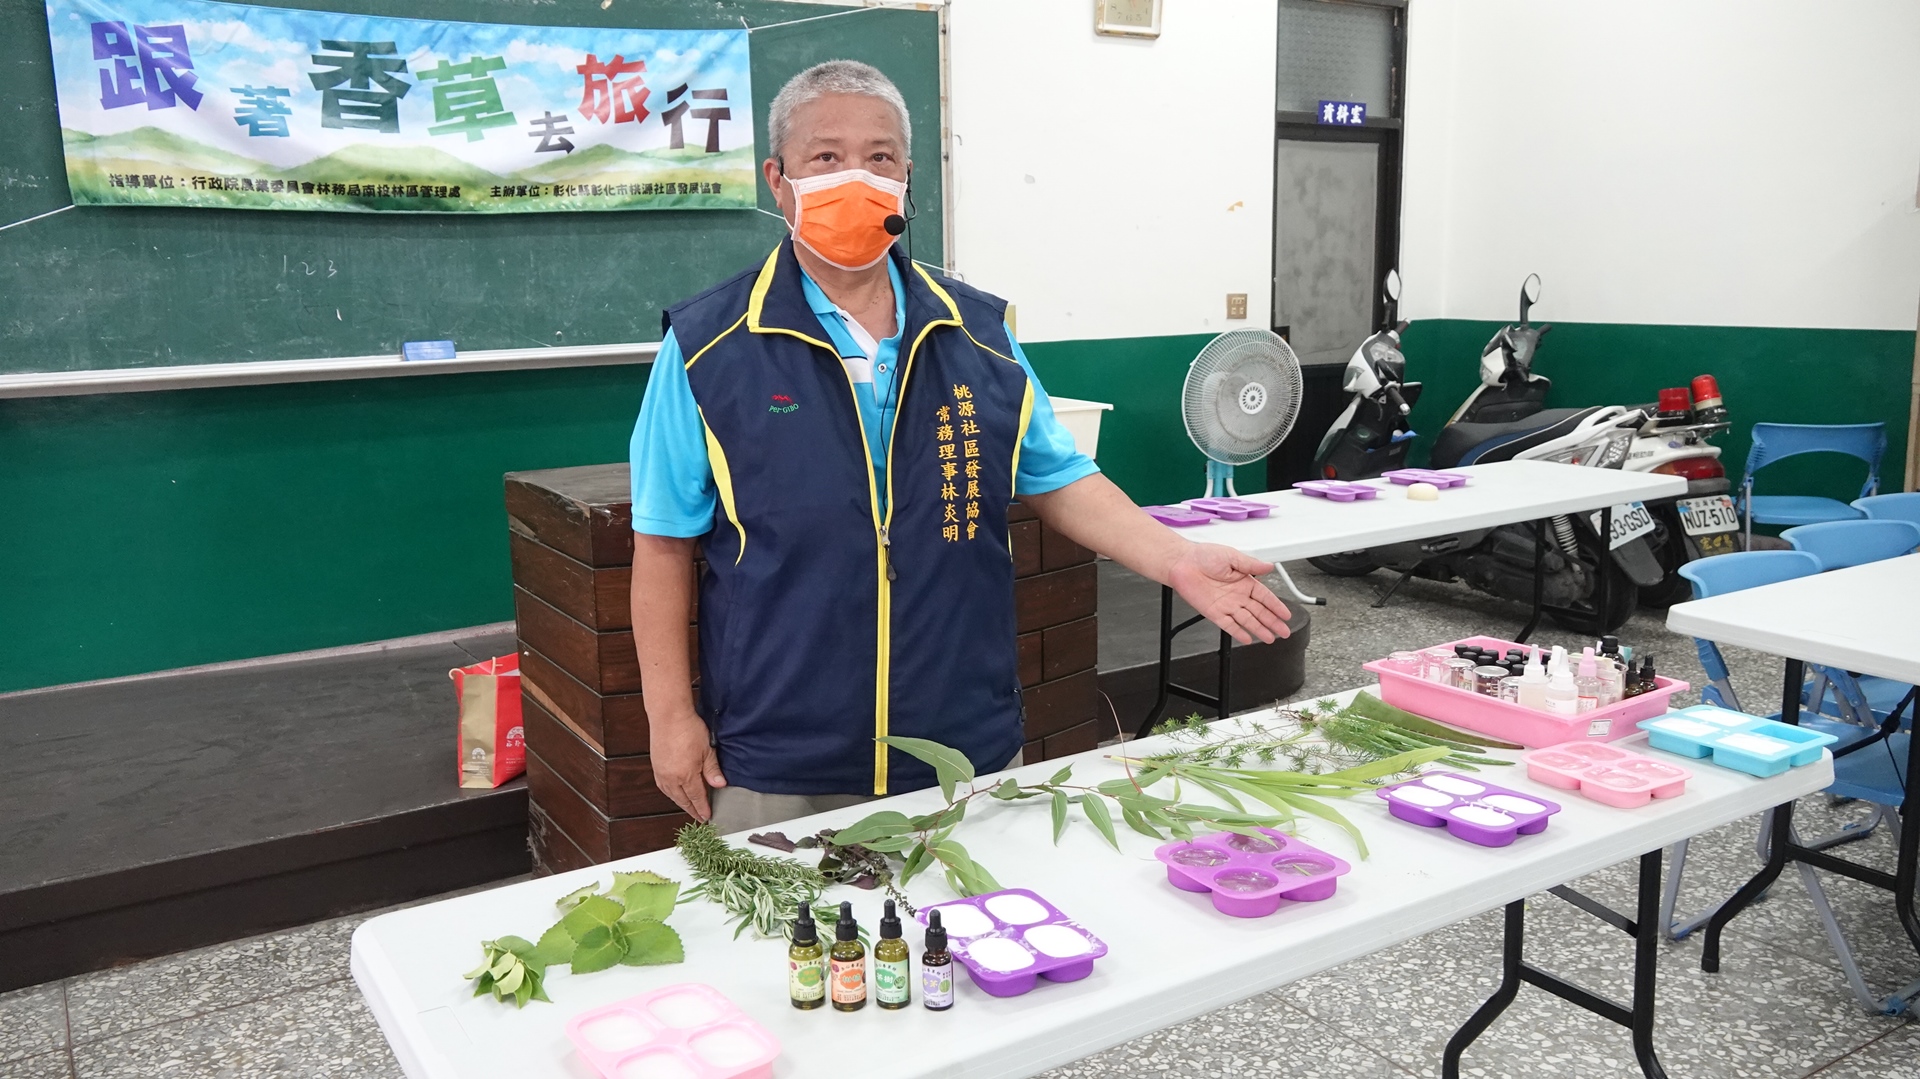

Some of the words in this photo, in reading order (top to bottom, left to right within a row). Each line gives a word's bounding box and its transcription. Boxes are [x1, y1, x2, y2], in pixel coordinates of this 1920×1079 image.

[90, 20, 731, 153] 跟著香草去旅行
[1323, 102, 1364, 124] 資料室
[936, 405, 960, 542] 常務理事林炎明
[953, 383, 982, 541] 桃源社區發展協會
[1608, 507, 1651, 542] 93-GSD
